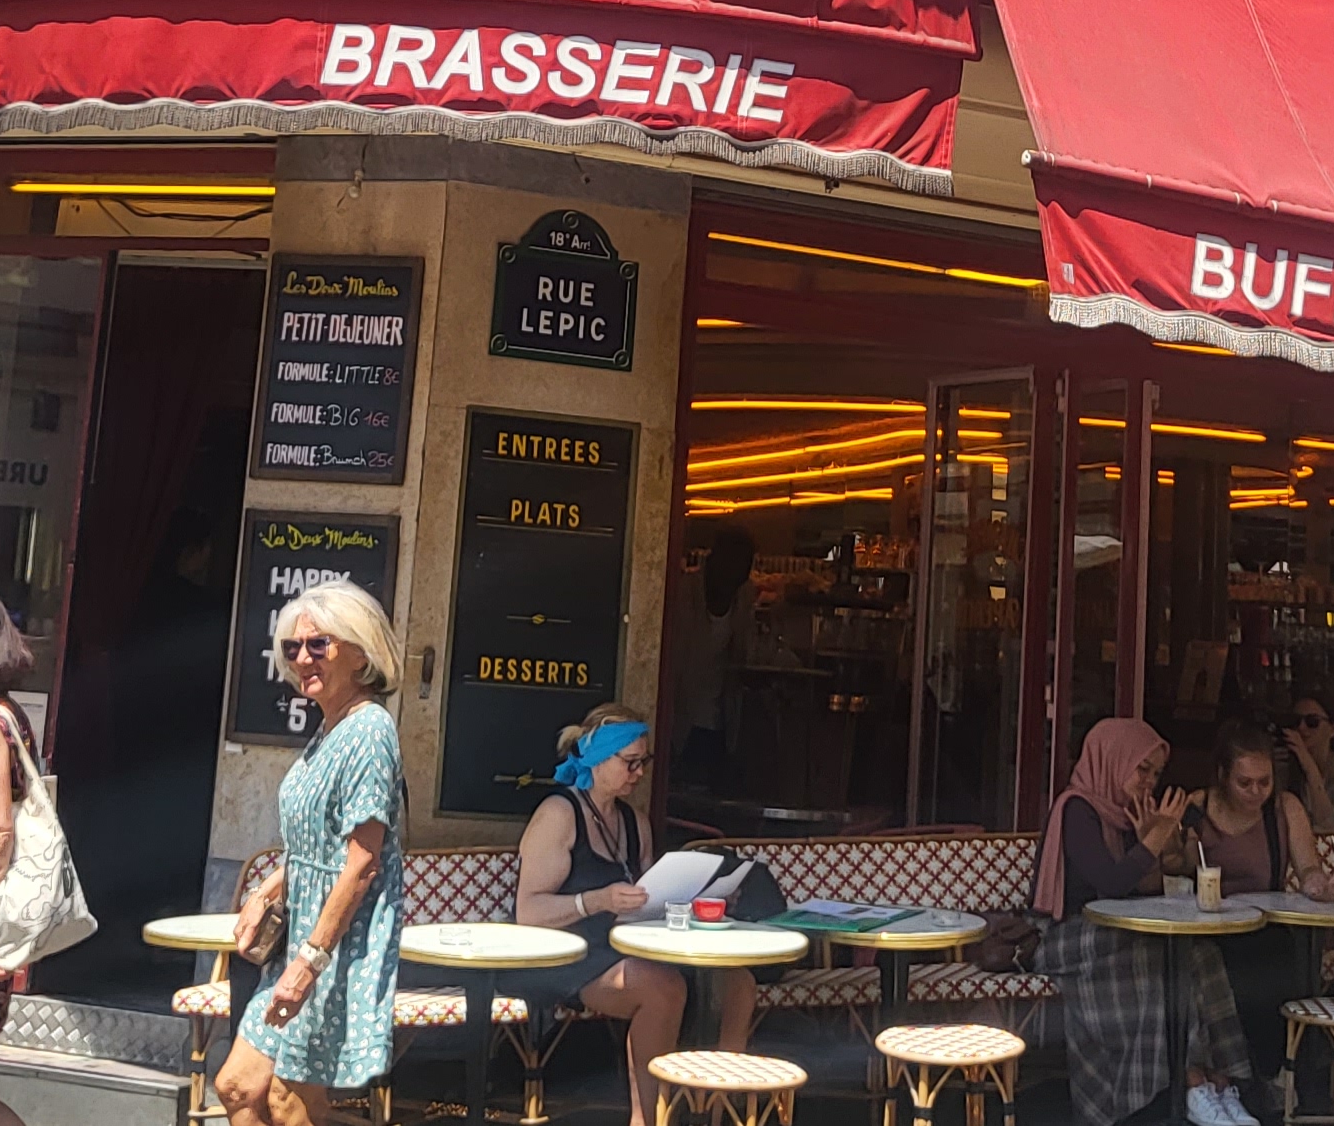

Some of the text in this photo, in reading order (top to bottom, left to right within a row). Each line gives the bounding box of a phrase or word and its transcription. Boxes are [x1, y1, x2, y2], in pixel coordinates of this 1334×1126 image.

[321, 24, 794, 123] BRASSERIE
[283, 270, 307, 294] Les
[343, 276, 399, 297] Moulins
[538, 276, 595, 307] RUE
[521, 307, 606, 341] LEPIC
[335, 364, 384, 384] LITTLE
[328, 404, 361, 426] BIG
[364, 411, 390, 427] 16€
[320, 445, 366, 466] Brunch
[368, 451, 395, 467] 25€
[510, 499, 580, 528] PLATS
[480, 656, 587, 686] DESSERTS
